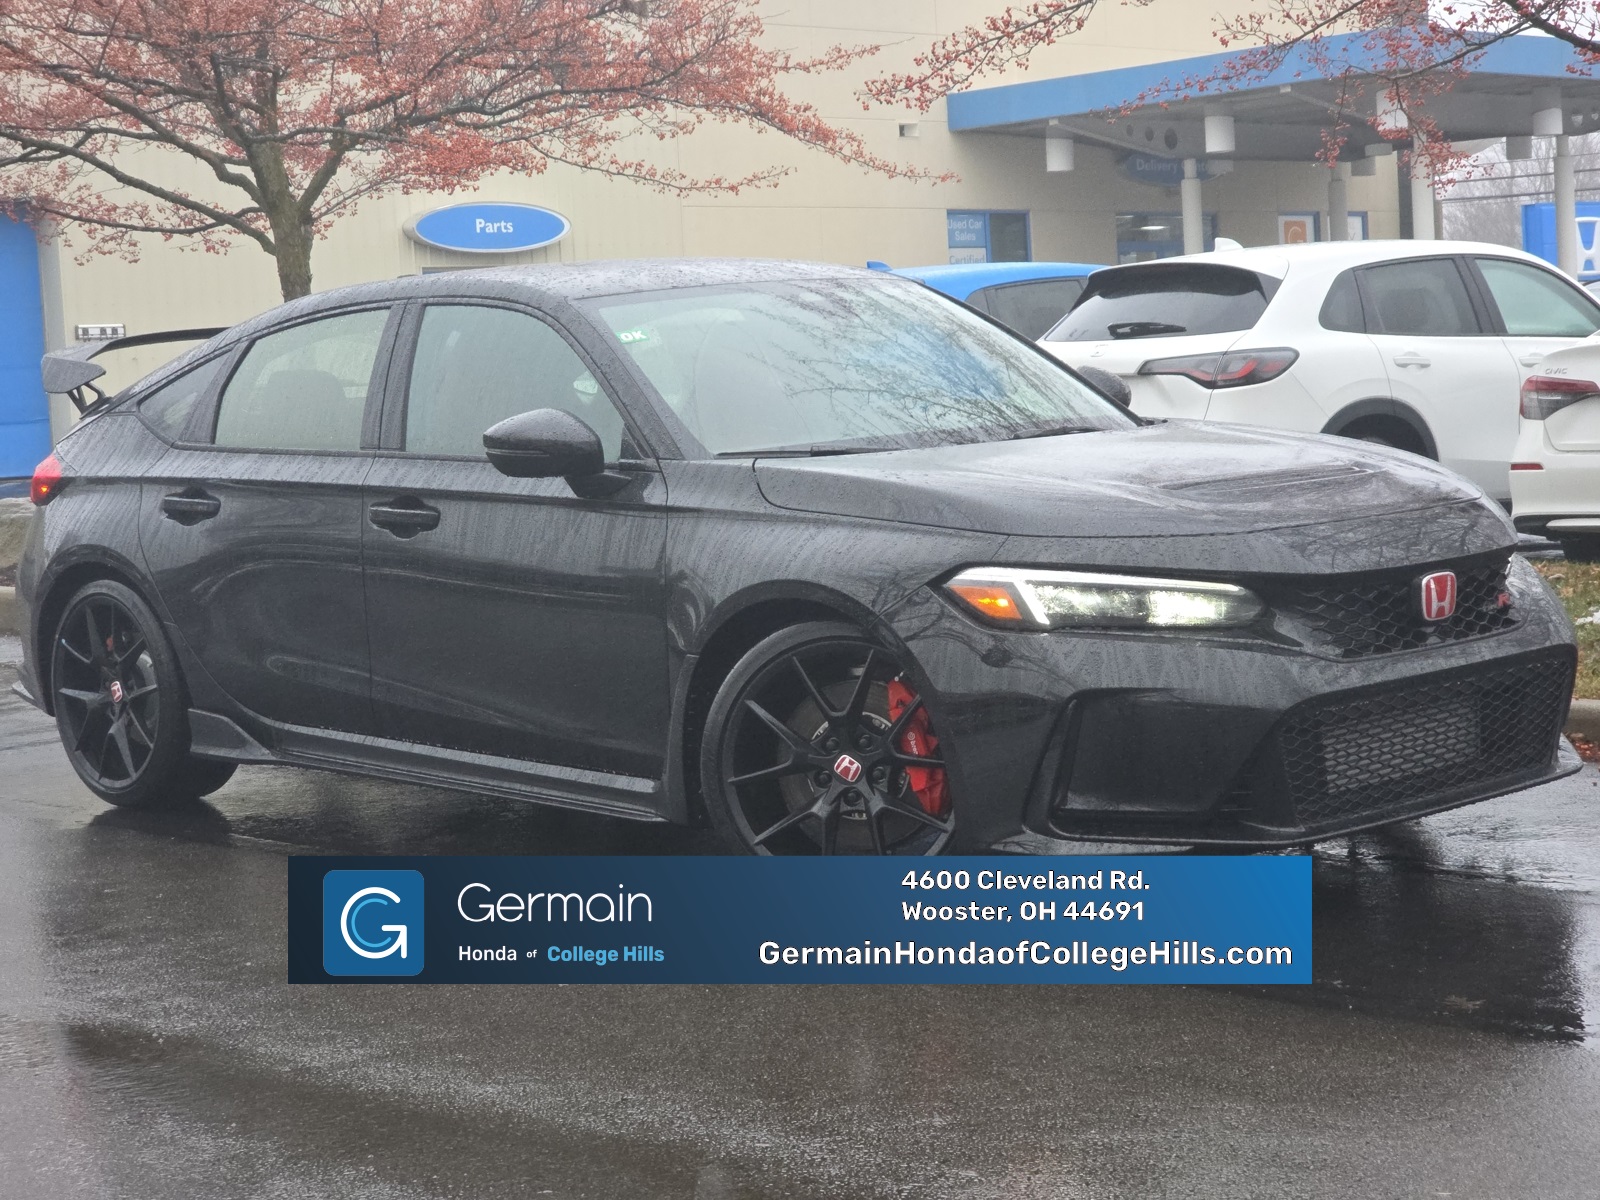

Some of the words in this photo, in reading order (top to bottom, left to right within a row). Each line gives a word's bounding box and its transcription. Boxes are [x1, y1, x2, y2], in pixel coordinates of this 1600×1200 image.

[1136, 159, 1177, 174] Delivery
[475, 218, 514, 233] Parts
[947, 219, 967, 229] Used
[968, 219, 983, 229] Car
[954, 231, 976, 241] Sales
[949, 254, 985, 264] Certified
[620, 330, 647, 341] OK
[1545, 367, 1568, 375] CIVIC
